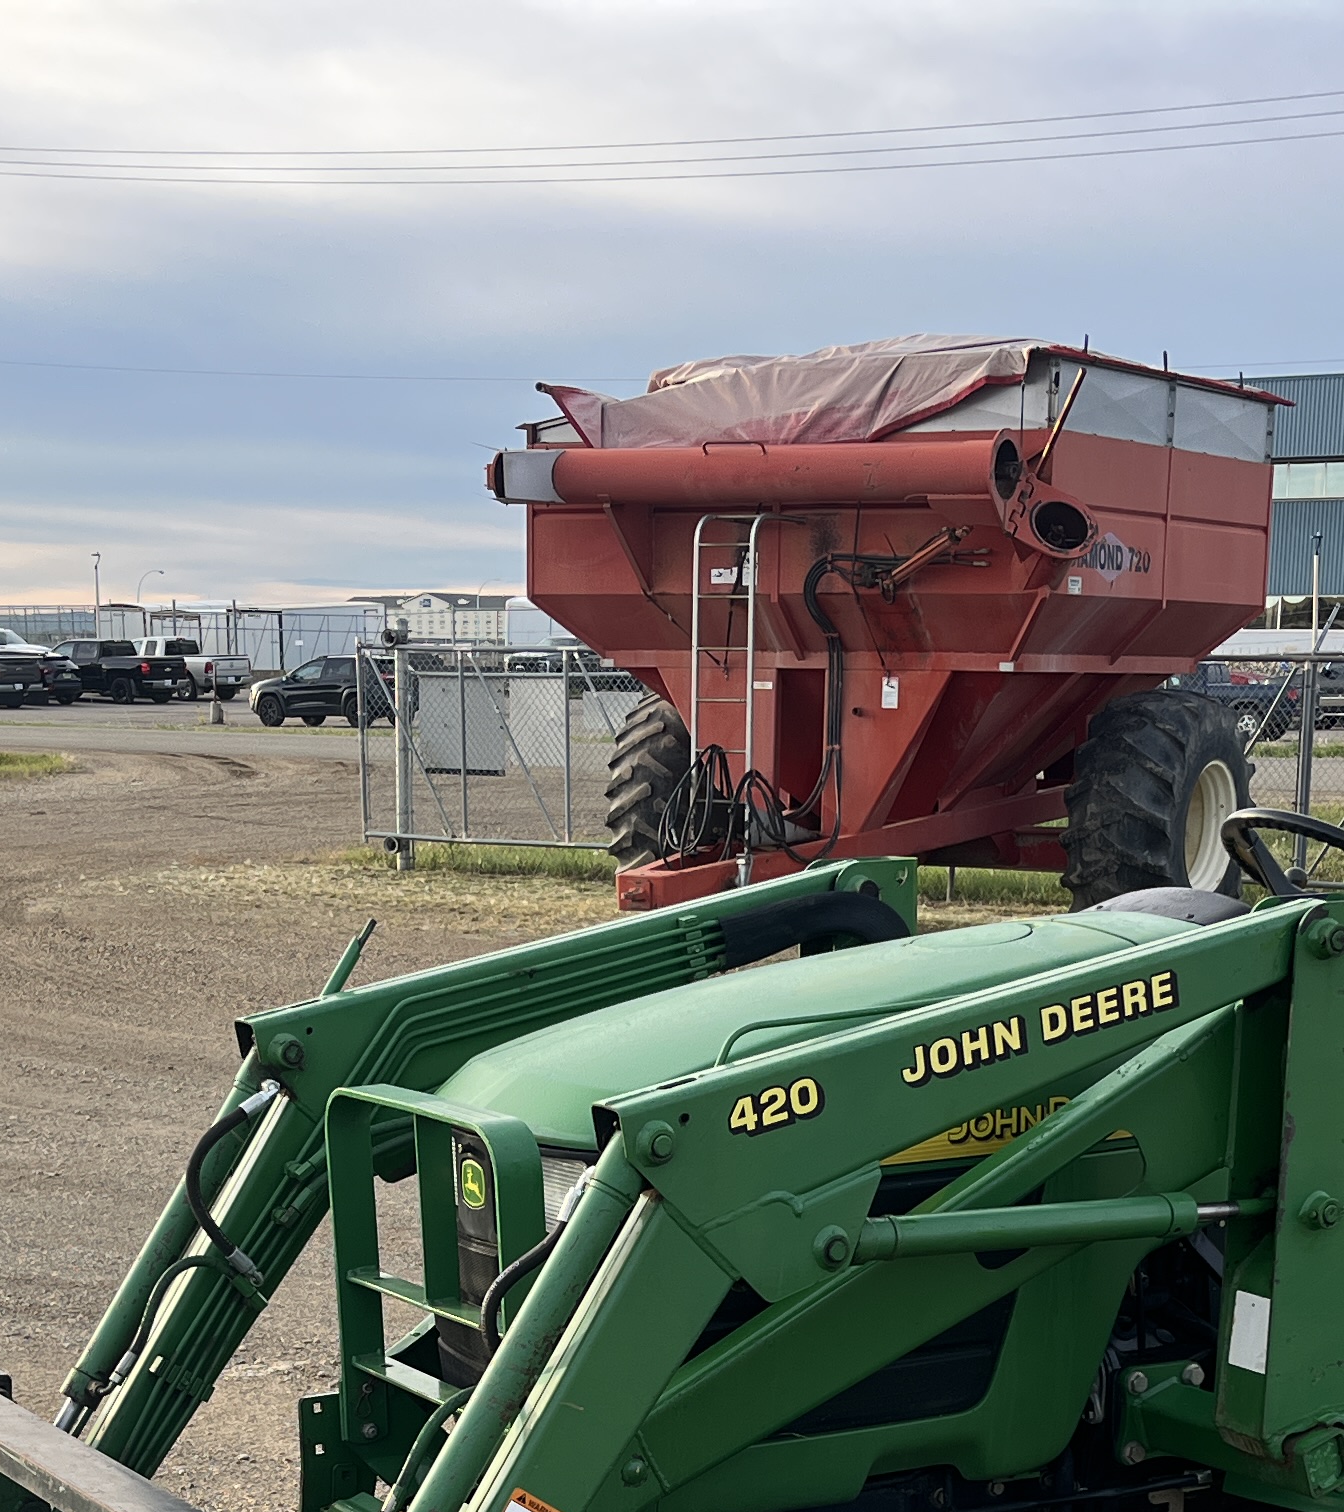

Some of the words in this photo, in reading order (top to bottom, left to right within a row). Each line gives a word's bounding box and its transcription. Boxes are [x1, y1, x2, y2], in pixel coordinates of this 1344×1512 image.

[1071, 542, 1123, 571] AMOND
[1128, 546, 1151, 573] 720
[901, 1015, 1025, 1086] JOHN
[1040, 970, 1177, 1044] DEERE
[729, 1077, 821, 1134] 420
